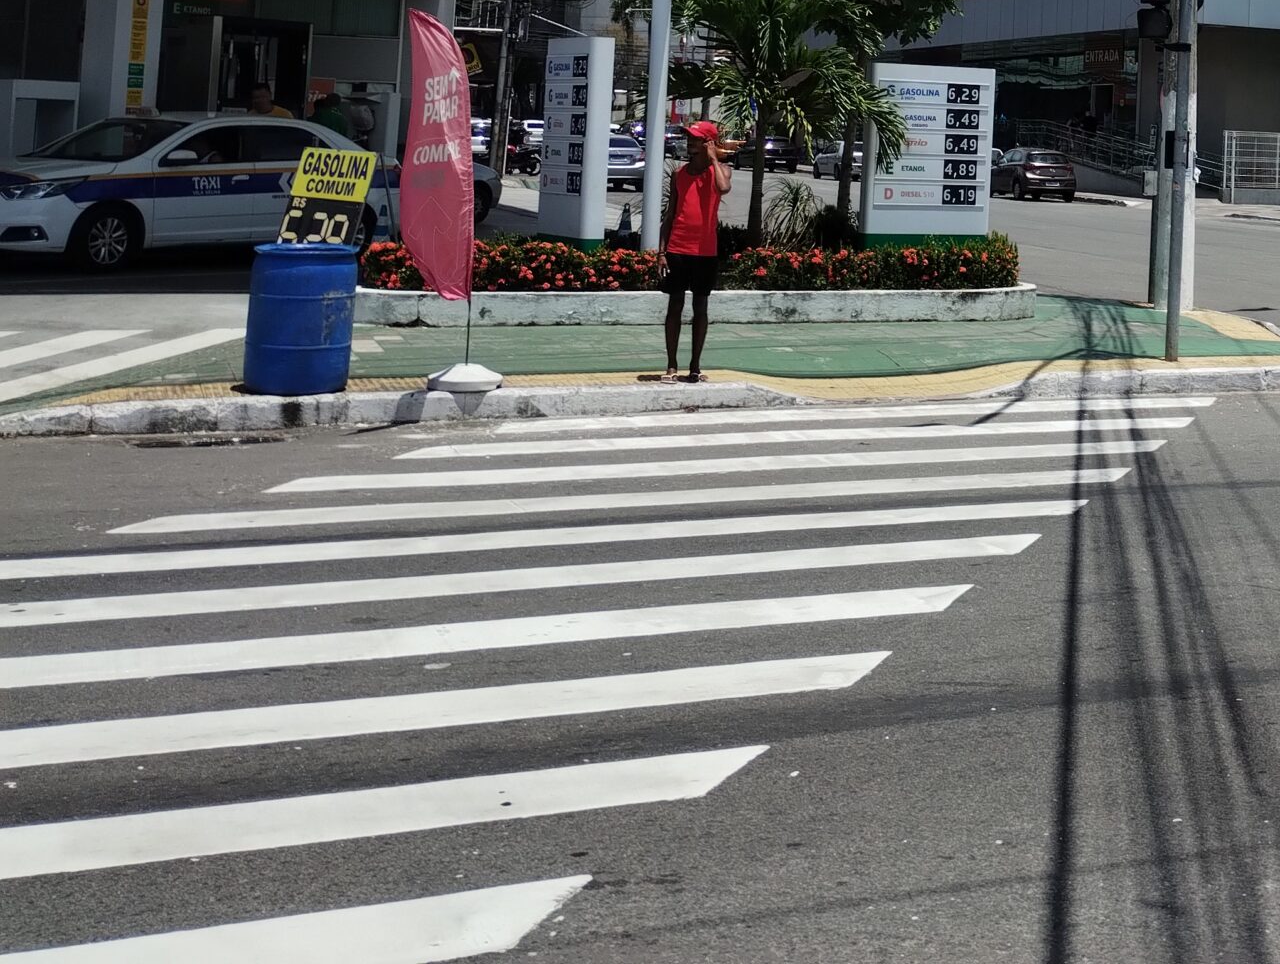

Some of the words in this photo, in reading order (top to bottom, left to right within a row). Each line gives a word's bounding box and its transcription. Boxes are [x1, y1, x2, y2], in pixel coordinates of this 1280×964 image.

[1085, 49, 1119, 63] ENTRADA
[425, 74, 448, 102] SEM
[900, 87, 940, 97] GASOLINA
[948, 88, 979, 103] 6,29
[947, 113, 978, 127] 6,49
[413, 139, 462, 166] COMPRE
[945, 138, 977, 153] 6,49
[302, 151, 370, 180] GASOLINA
[901, 165, 926, 173] ETANOL
[944, 163, 976, 178] 4,89
[191, 176, 221, 190] TAXI
[305, 178, 356, 197] COMUM
[884, 188, 894, 200] D
[900, 190, 921, 198] DIESEL
[943, 189, 975, 203] 6,19
